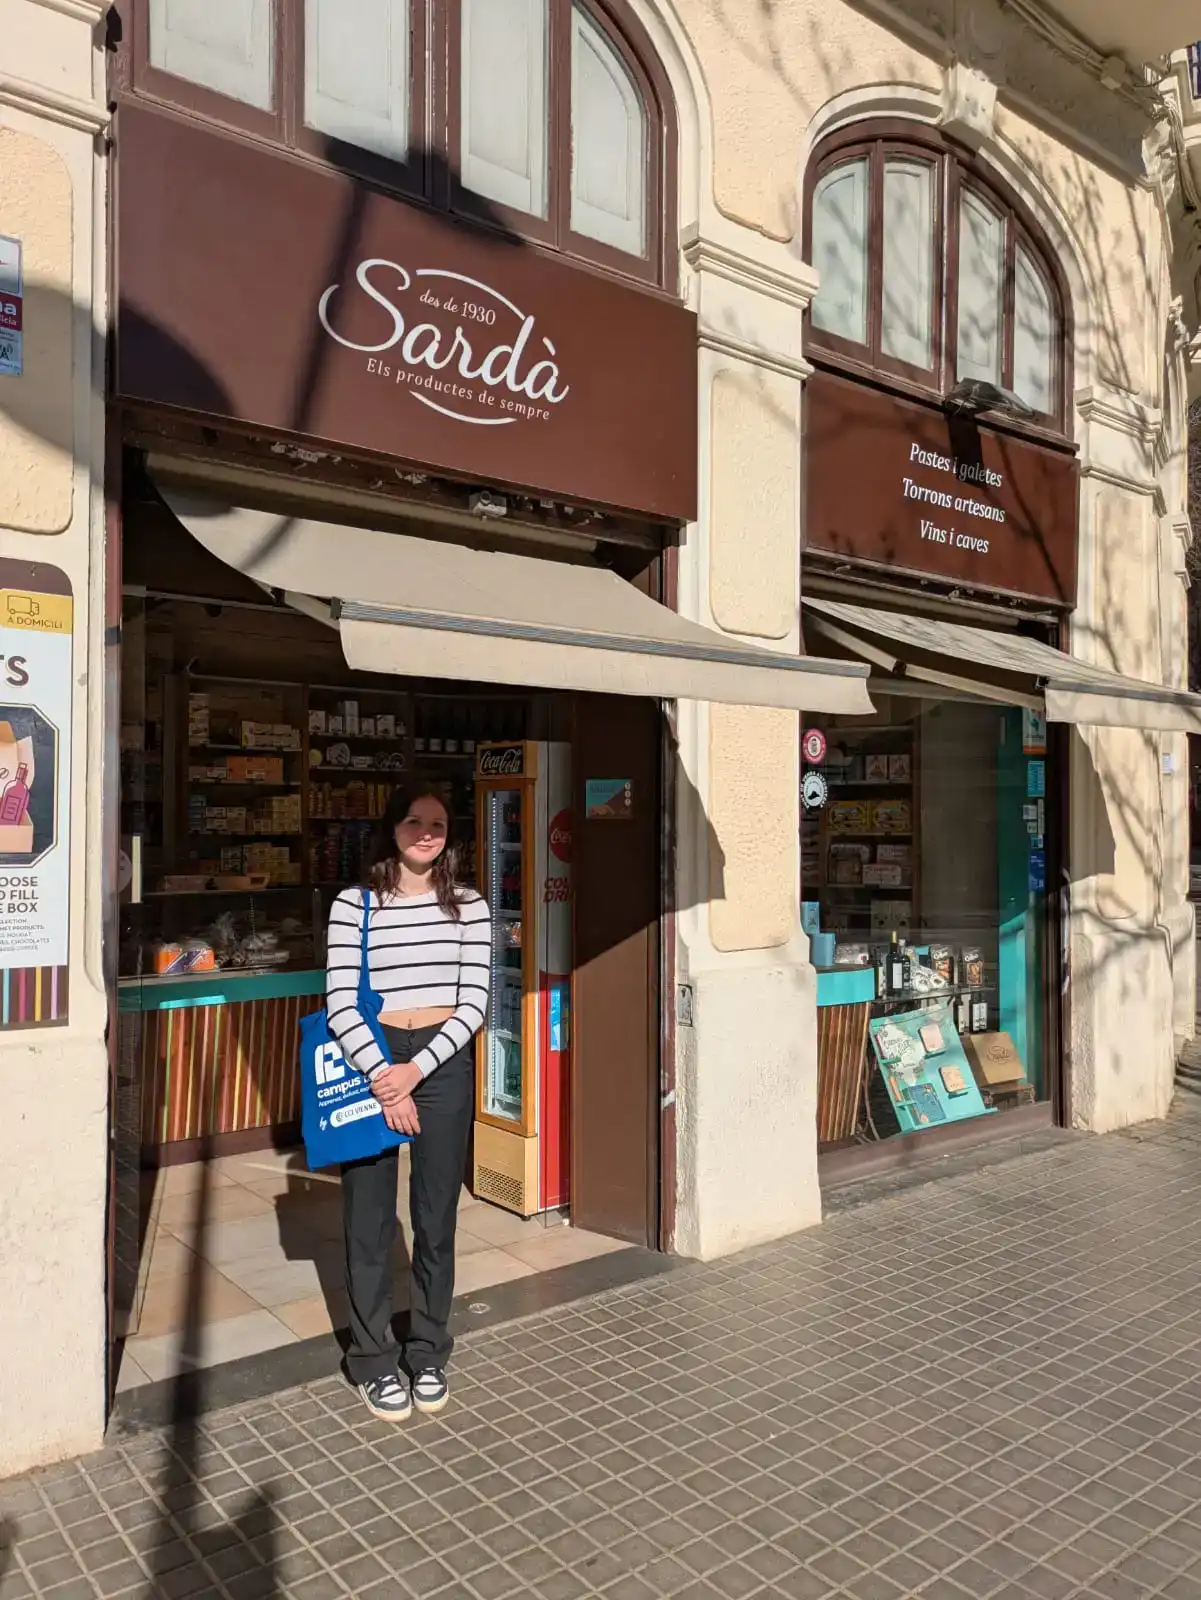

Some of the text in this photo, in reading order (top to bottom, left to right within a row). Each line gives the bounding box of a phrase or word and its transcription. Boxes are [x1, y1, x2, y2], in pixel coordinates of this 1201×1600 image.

[419, 288, 496, 325] des de 1930
[318, 258, 570, 404] Sardà
[366, 357, 551, 421] Els productes de sempre
[909, 442, 1002, 488] Pastes i galetes
[902, 477, 1006, 523] Torrons artesans
[920, 519, 990, 553] Vins i caves
[16, 616, 63, 629] DOMICILI
[7, 902, 38, 914] BOX
[10, 889, 39, 901] FILL
[317, 1076, 361, 1099] campus
[354, 1102, 378, 1114] VIENNE
